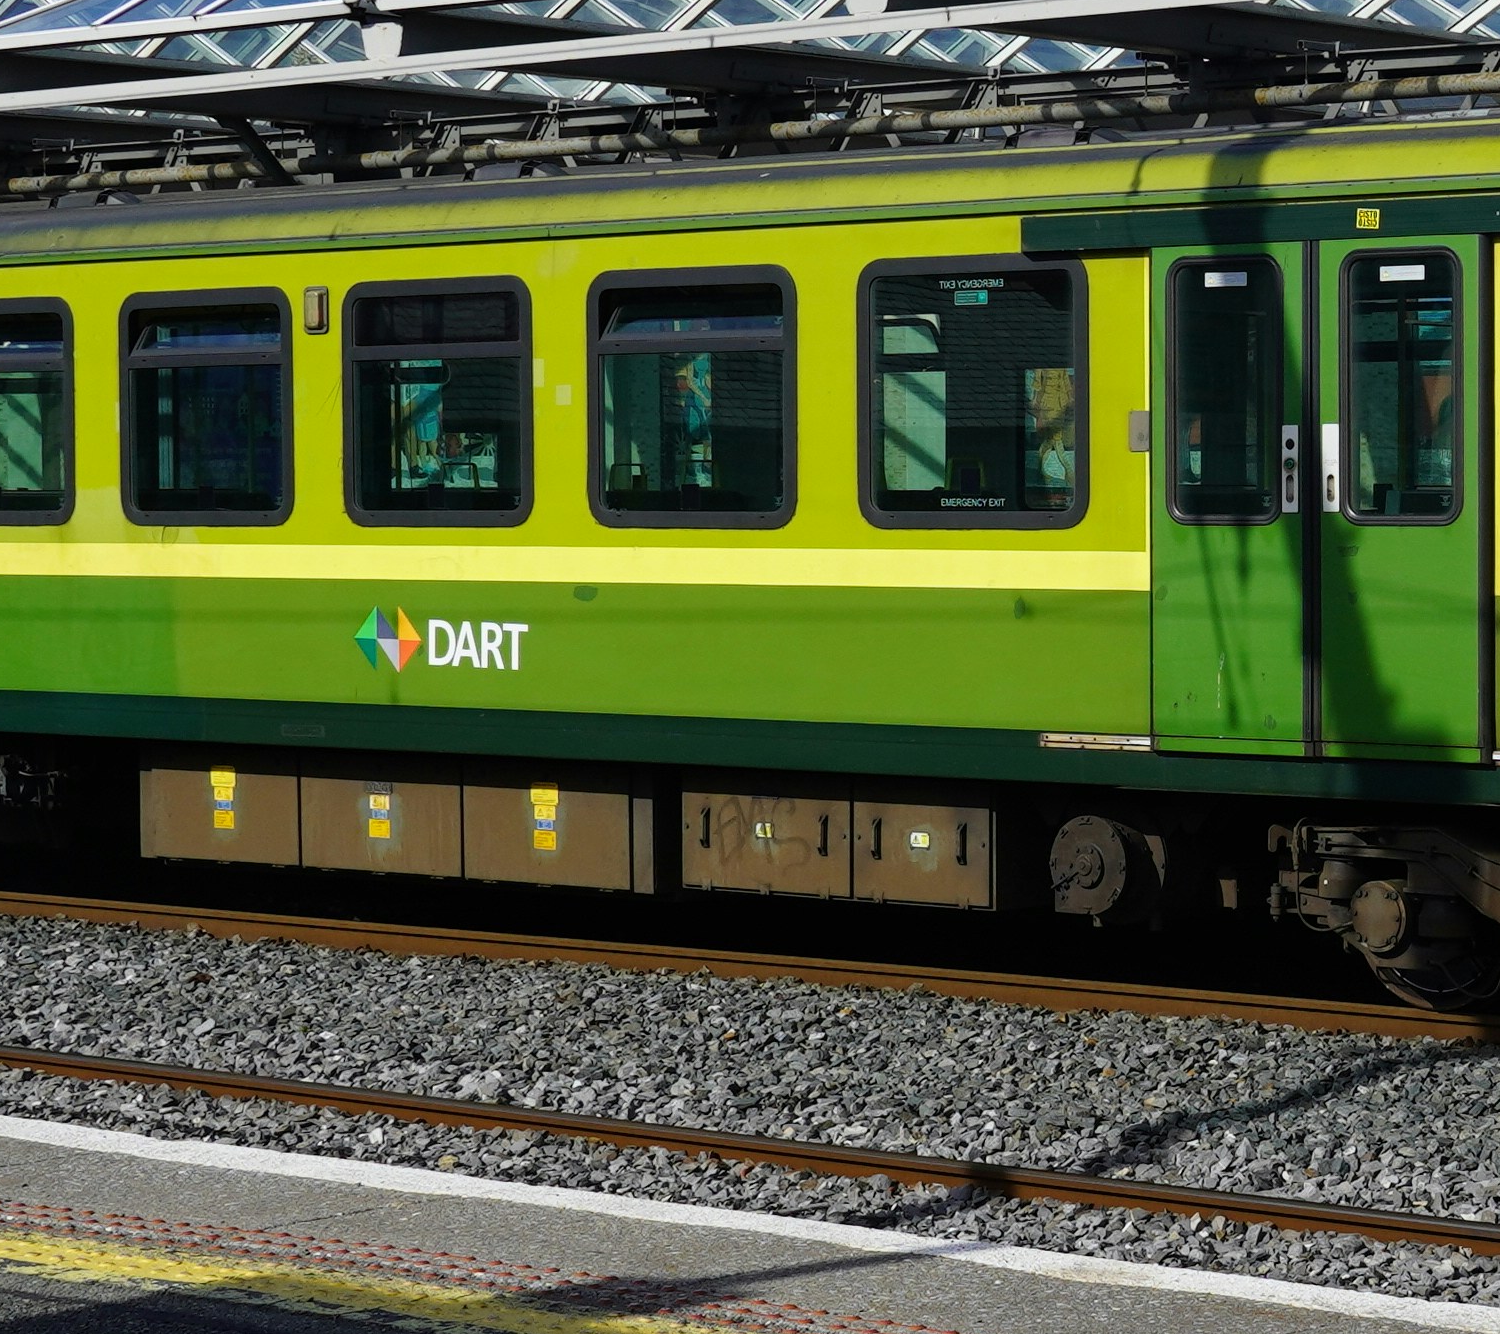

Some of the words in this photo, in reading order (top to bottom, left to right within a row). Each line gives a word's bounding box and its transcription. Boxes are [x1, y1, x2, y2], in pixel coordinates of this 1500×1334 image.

[941, 498, 987, 507] EMERGENCY
[988, 498, 1006, 507] EXIT
[428, 619, 529, 671] DART
